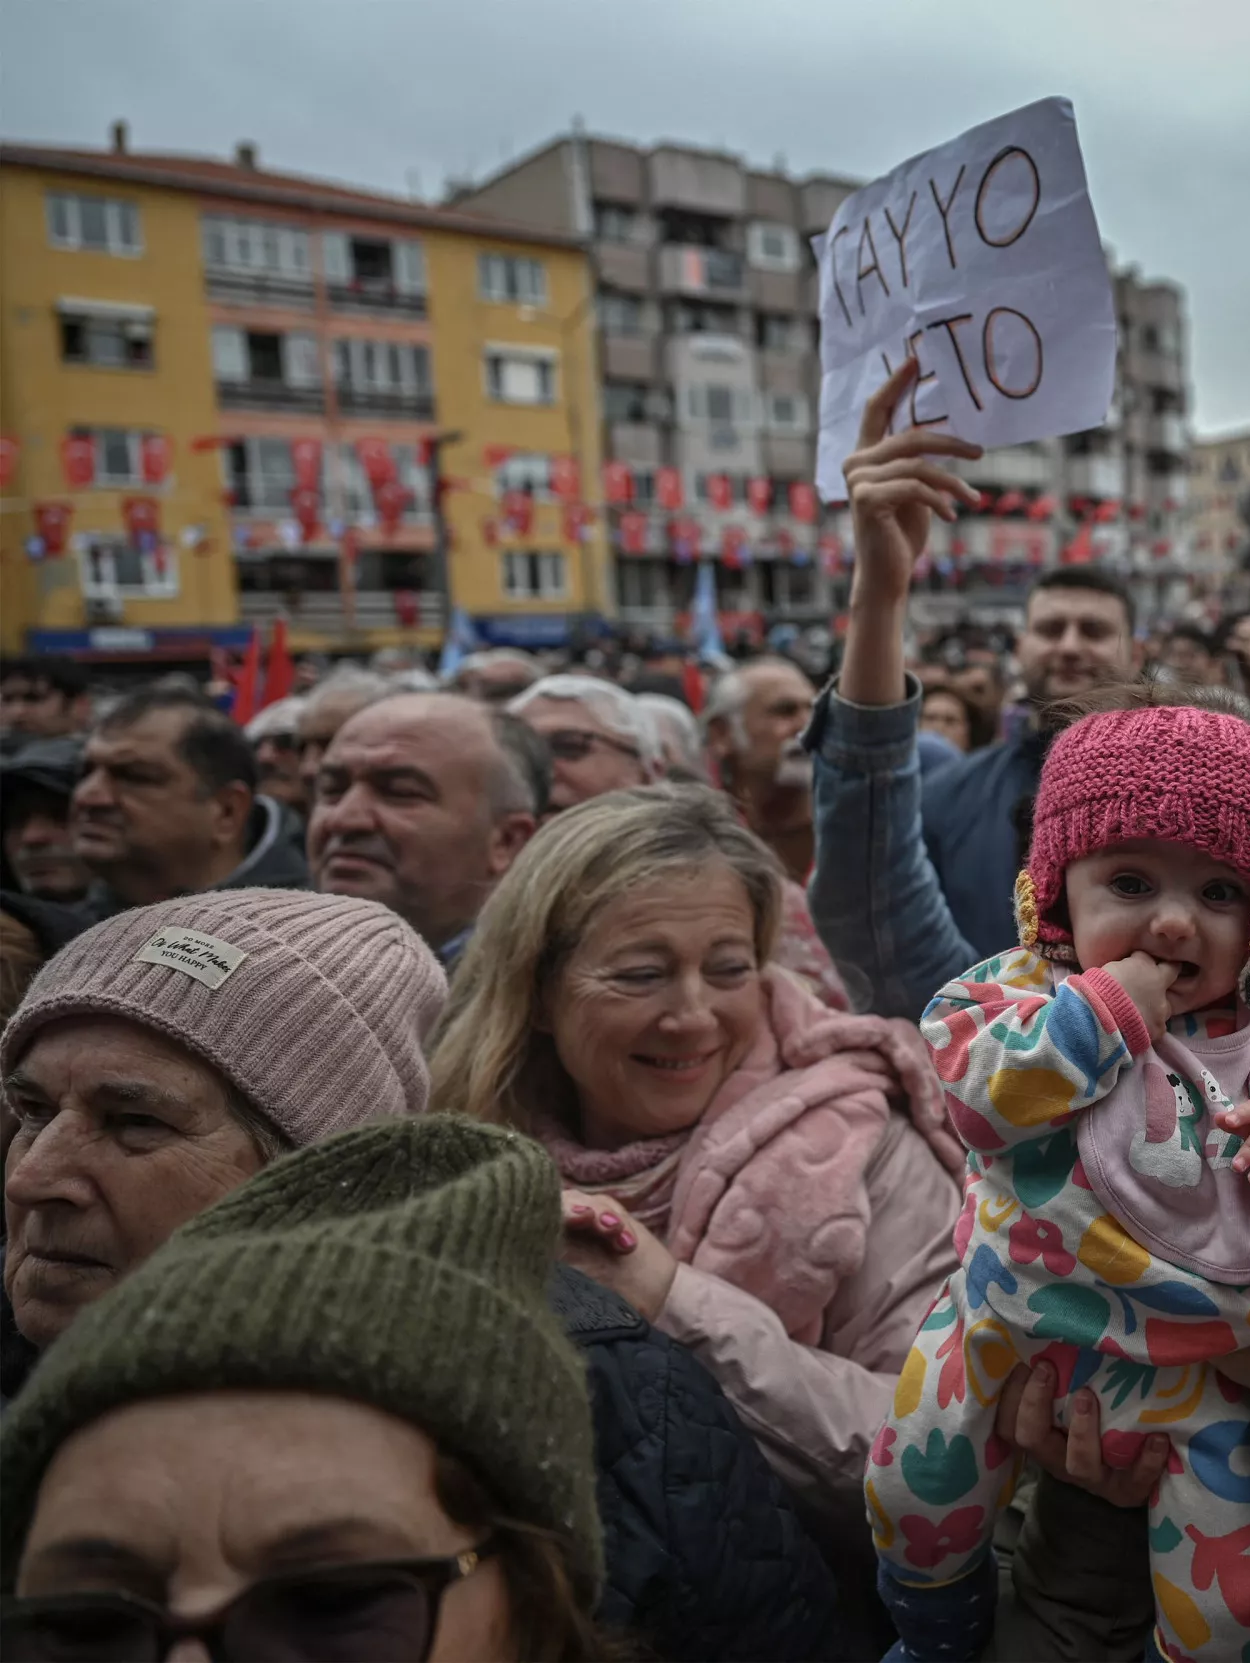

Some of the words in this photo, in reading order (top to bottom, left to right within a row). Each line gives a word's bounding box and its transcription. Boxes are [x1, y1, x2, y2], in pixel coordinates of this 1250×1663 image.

[832, 145, 1040, 327] TAYYO
[195, 940, 214, 949] MORE
[167, 940, 200, 955] What
[198, 950, 231, 973] Makes
[178, 956, 207, 970] HAPPY
